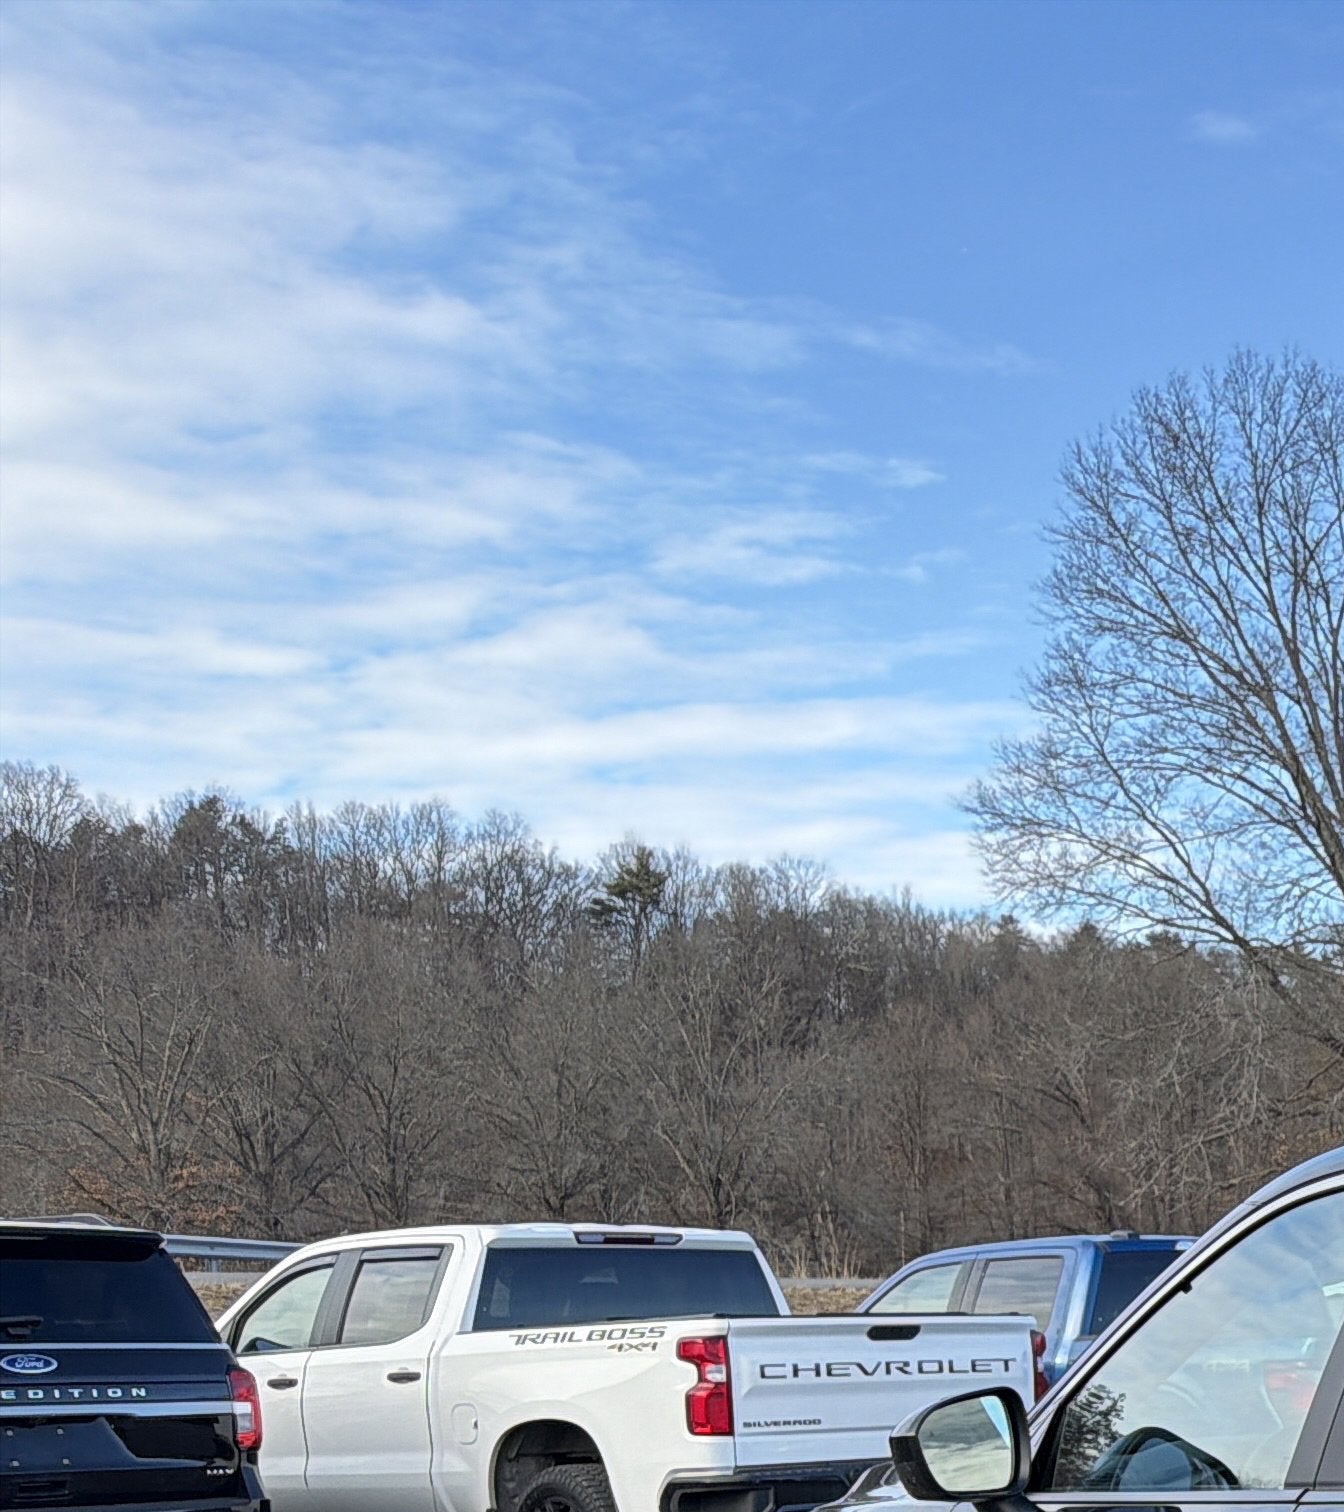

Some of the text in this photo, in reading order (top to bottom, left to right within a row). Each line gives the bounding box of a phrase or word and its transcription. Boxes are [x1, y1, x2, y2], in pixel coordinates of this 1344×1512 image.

[508, 1325, 668, 1346] TRAIL BOSS
[14, 1356, 45, 1368] Ford
[759, 1357, 1017, 1380] CHEVROLET
[742, 1418, 822, 1428] SILVERADO
